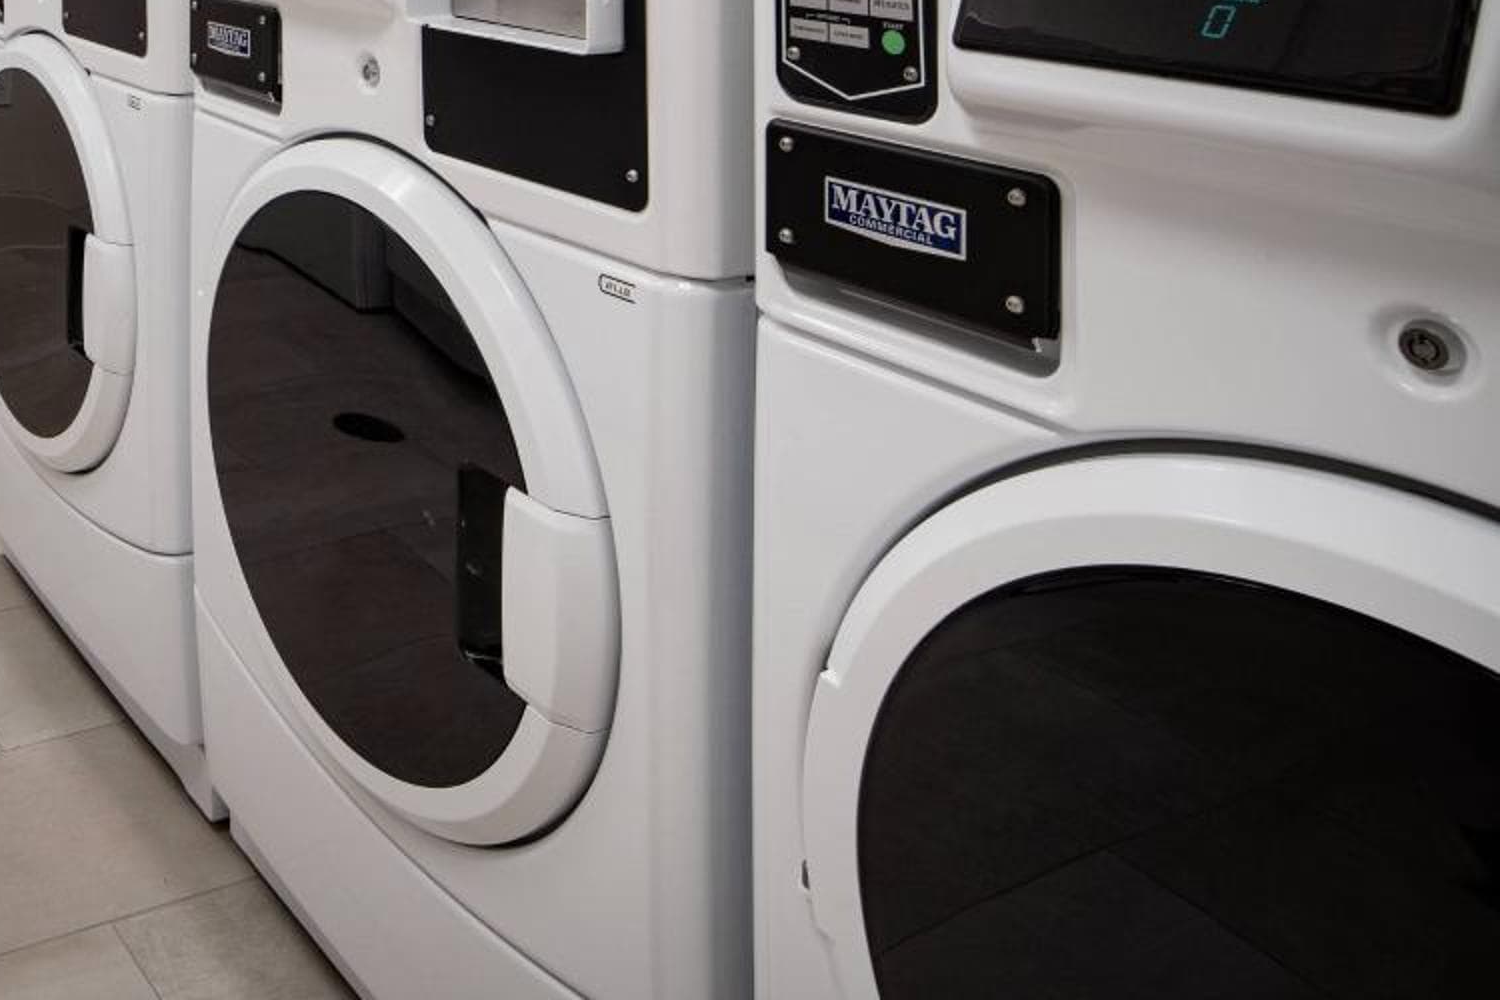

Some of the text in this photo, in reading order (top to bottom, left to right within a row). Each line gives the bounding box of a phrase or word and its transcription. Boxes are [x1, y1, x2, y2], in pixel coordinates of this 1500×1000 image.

[1201, 4, 1236, 40] 0
[831, 183, 957, 241] MAYTAG
[848, 213, 934, 247] COMMERCIAL
